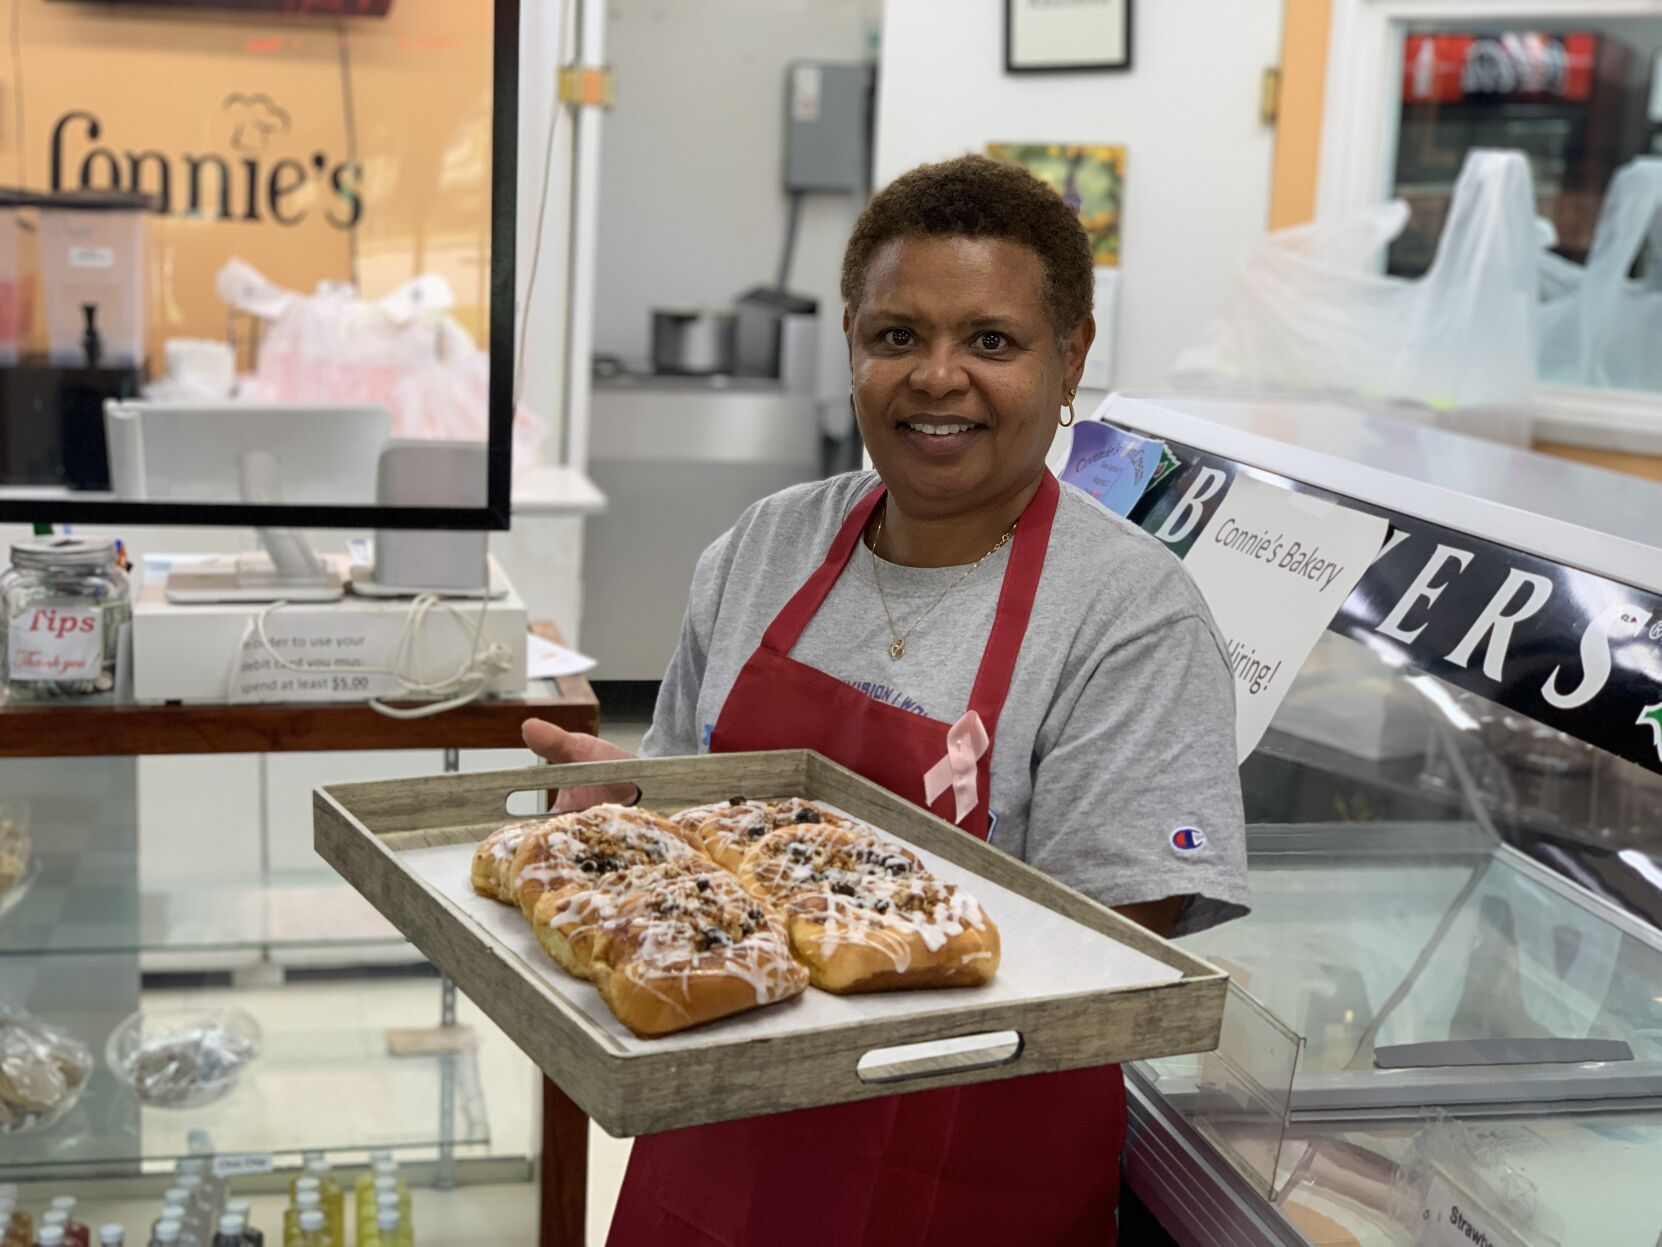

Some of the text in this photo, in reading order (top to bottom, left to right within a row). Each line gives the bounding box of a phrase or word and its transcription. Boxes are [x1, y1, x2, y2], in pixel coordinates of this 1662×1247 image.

[50, 110, 364, 231] Connie's
[1213, 518, 1344, 592] Connie's Bakery
[30, 608, 96, 639] Tips
